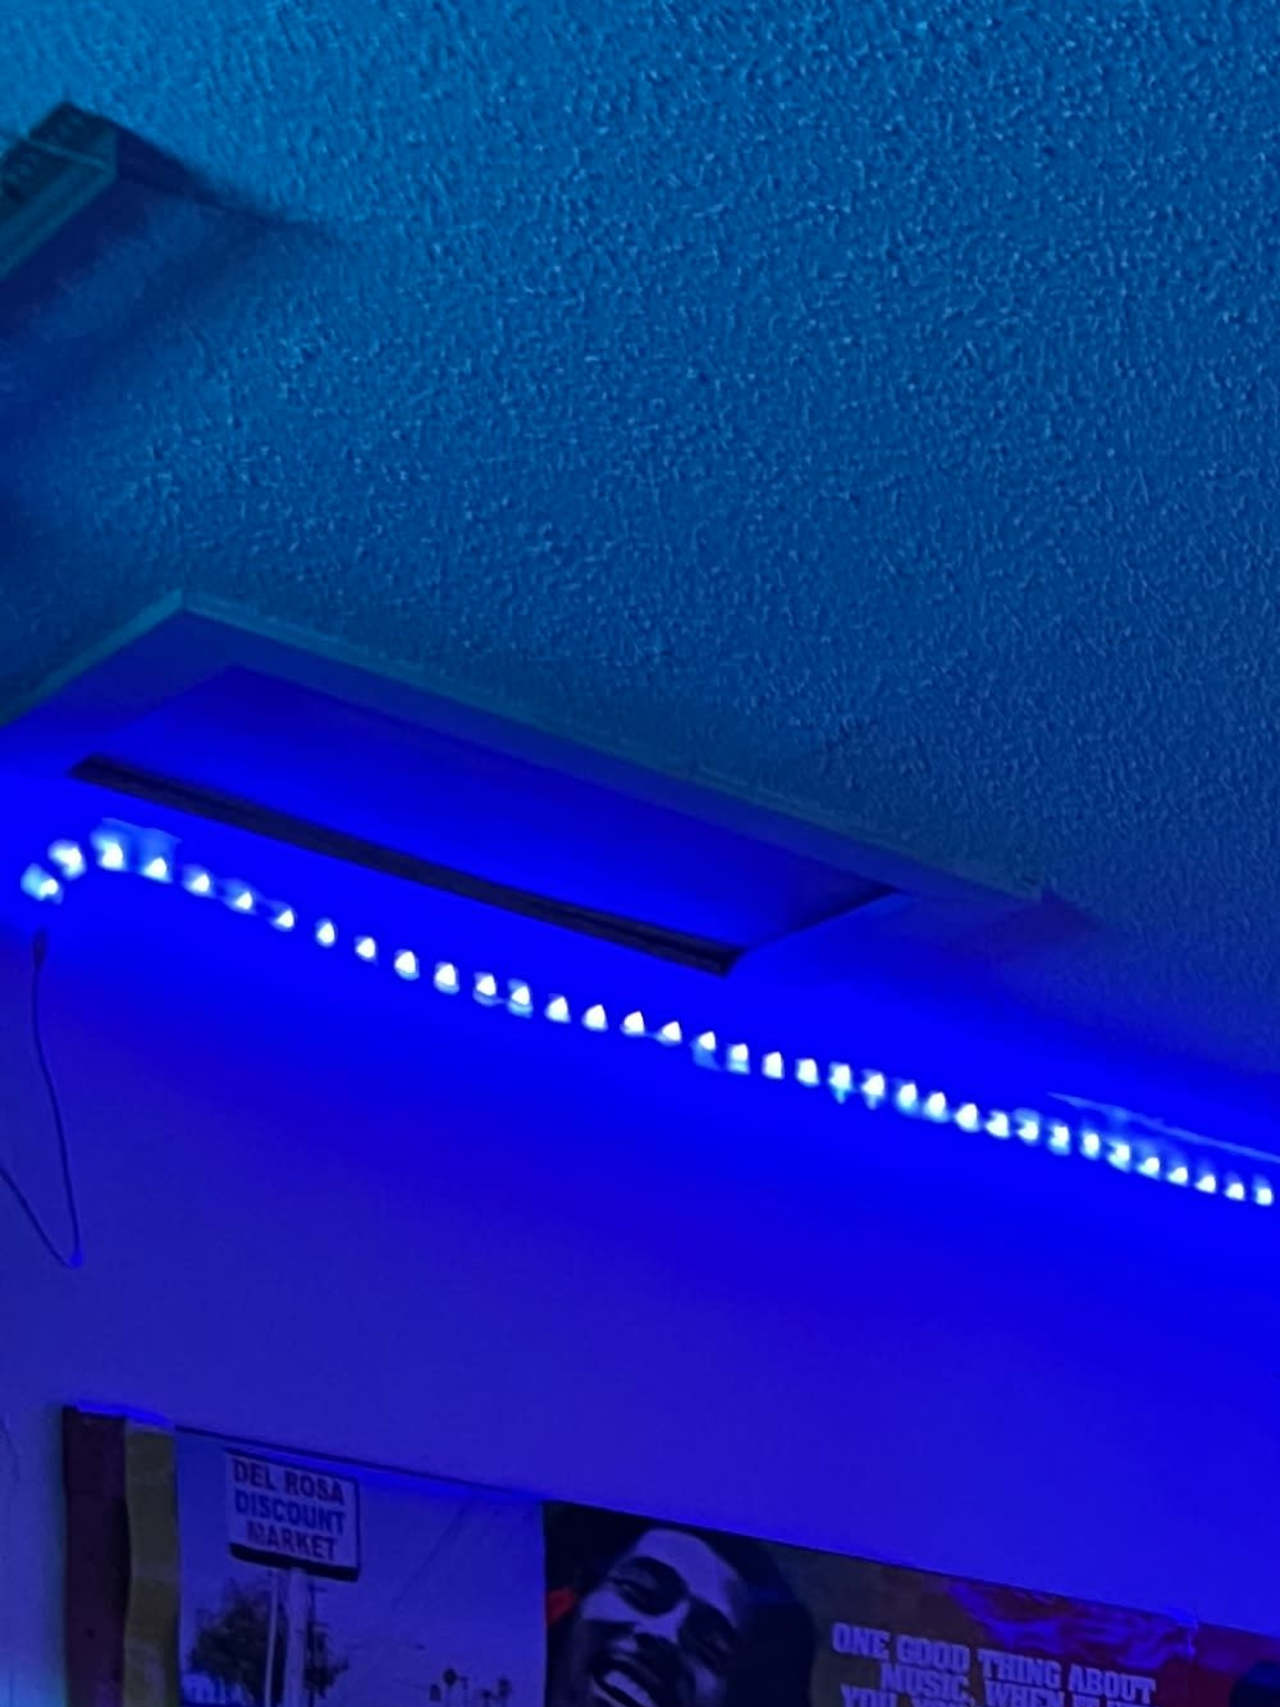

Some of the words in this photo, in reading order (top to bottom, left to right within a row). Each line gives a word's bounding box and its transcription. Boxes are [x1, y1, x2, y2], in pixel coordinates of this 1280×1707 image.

[232, 1458, 276, 1491] DEL
[284, 1470, 345, 1506] ROSA
[234, 1489, 346, 1534] DISCOUNT
[247, 1520, 338, 1561] MARKET
[832, 1622, 891, 1660] ONE
[896, 1634, 971, 1674] GOOD
[977, 1648, 1062, 1688] THING
[1067, 1664, 1157, 1703] ABOUT
[880, 1662, 975, 1707] MUSIC,
